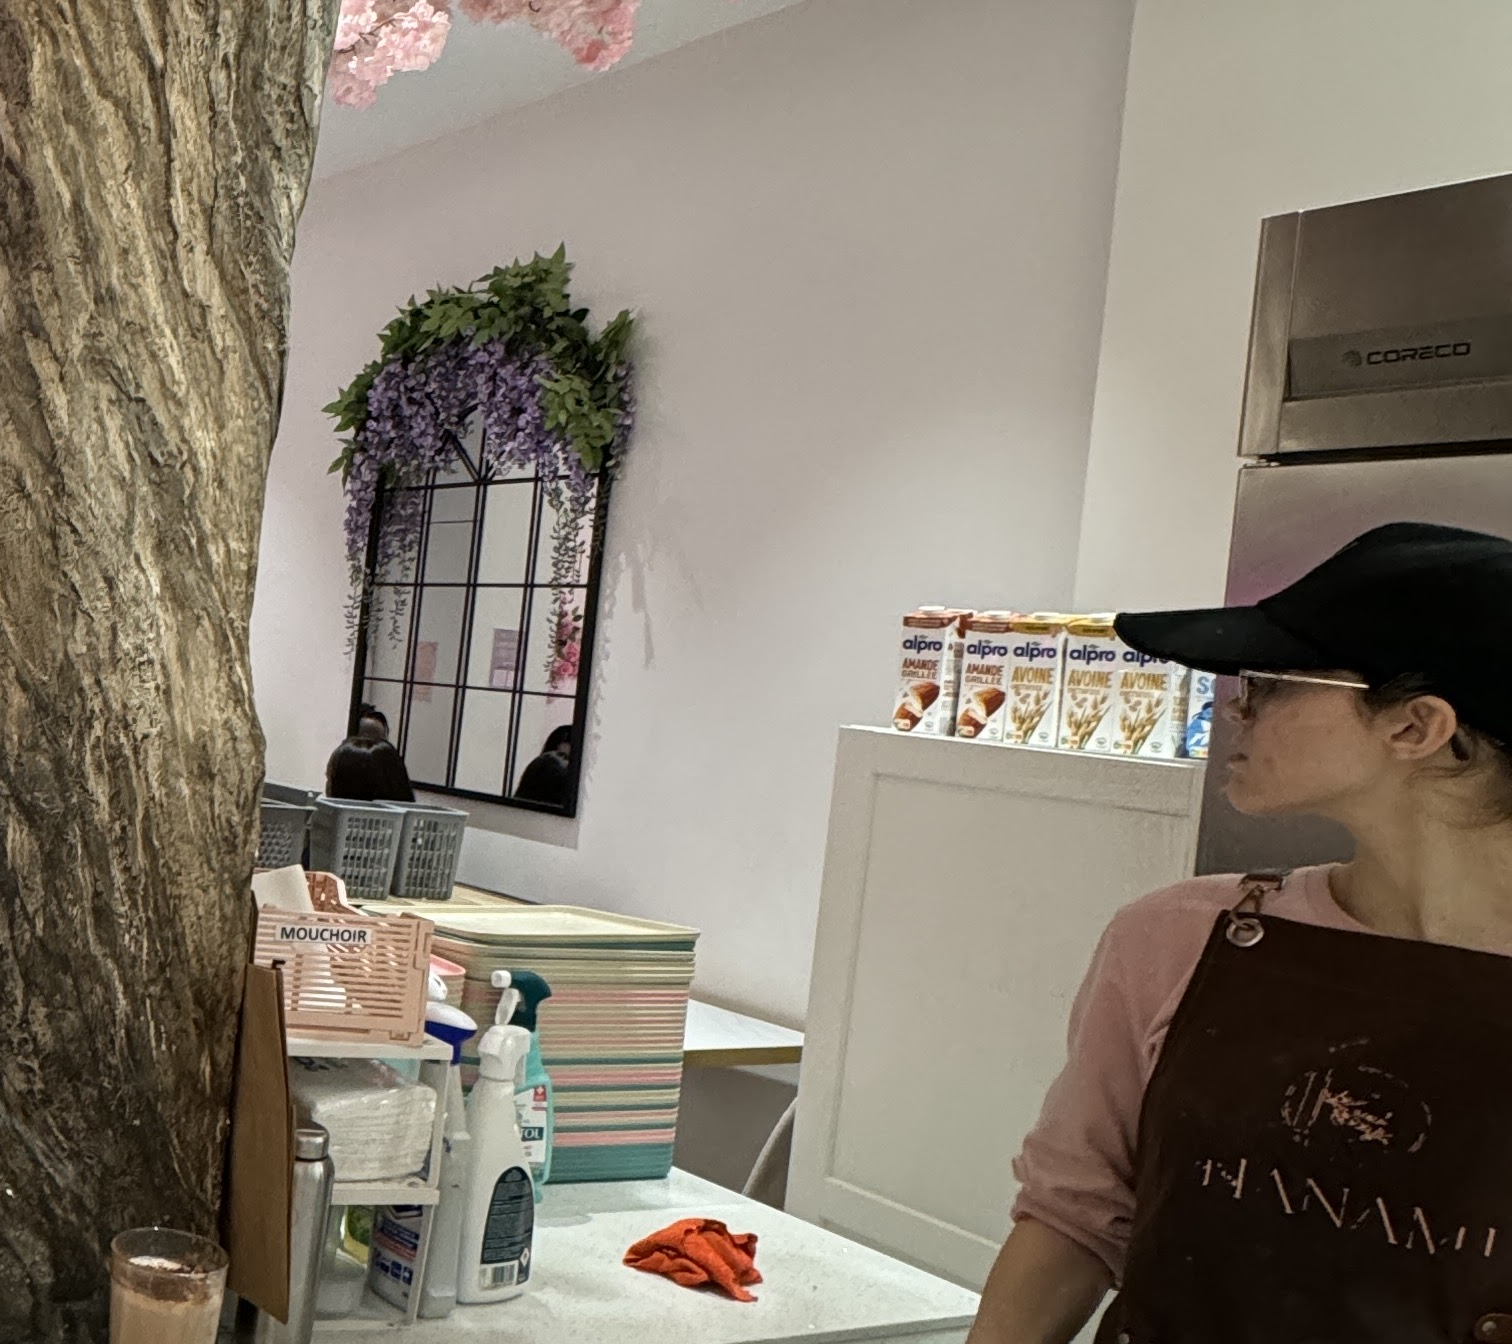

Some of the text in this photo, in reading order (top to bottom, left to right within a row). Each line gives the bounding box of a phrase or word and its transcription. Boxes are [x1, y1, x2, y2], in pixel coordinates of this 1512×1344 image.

[1368, 343, 1471, 366] CORECO
[902, 635, 943, 654] alpro
[966, 639, 1009, 660] alpro
[1013, 642, 1057, 662] alpro
[901, 657, 940, 671] AMANDE
[1069, 645, 1116, 665] alpro
[964, 663, 1005, 677] AMANDE
[1011, 666, 1055, 684] AVOINE
[1067, 669, 1114, 688] AVOINE
[1119, 671, 1169, 691] AVOINE
[280, 926, 367, 943] MOUCHOIR
